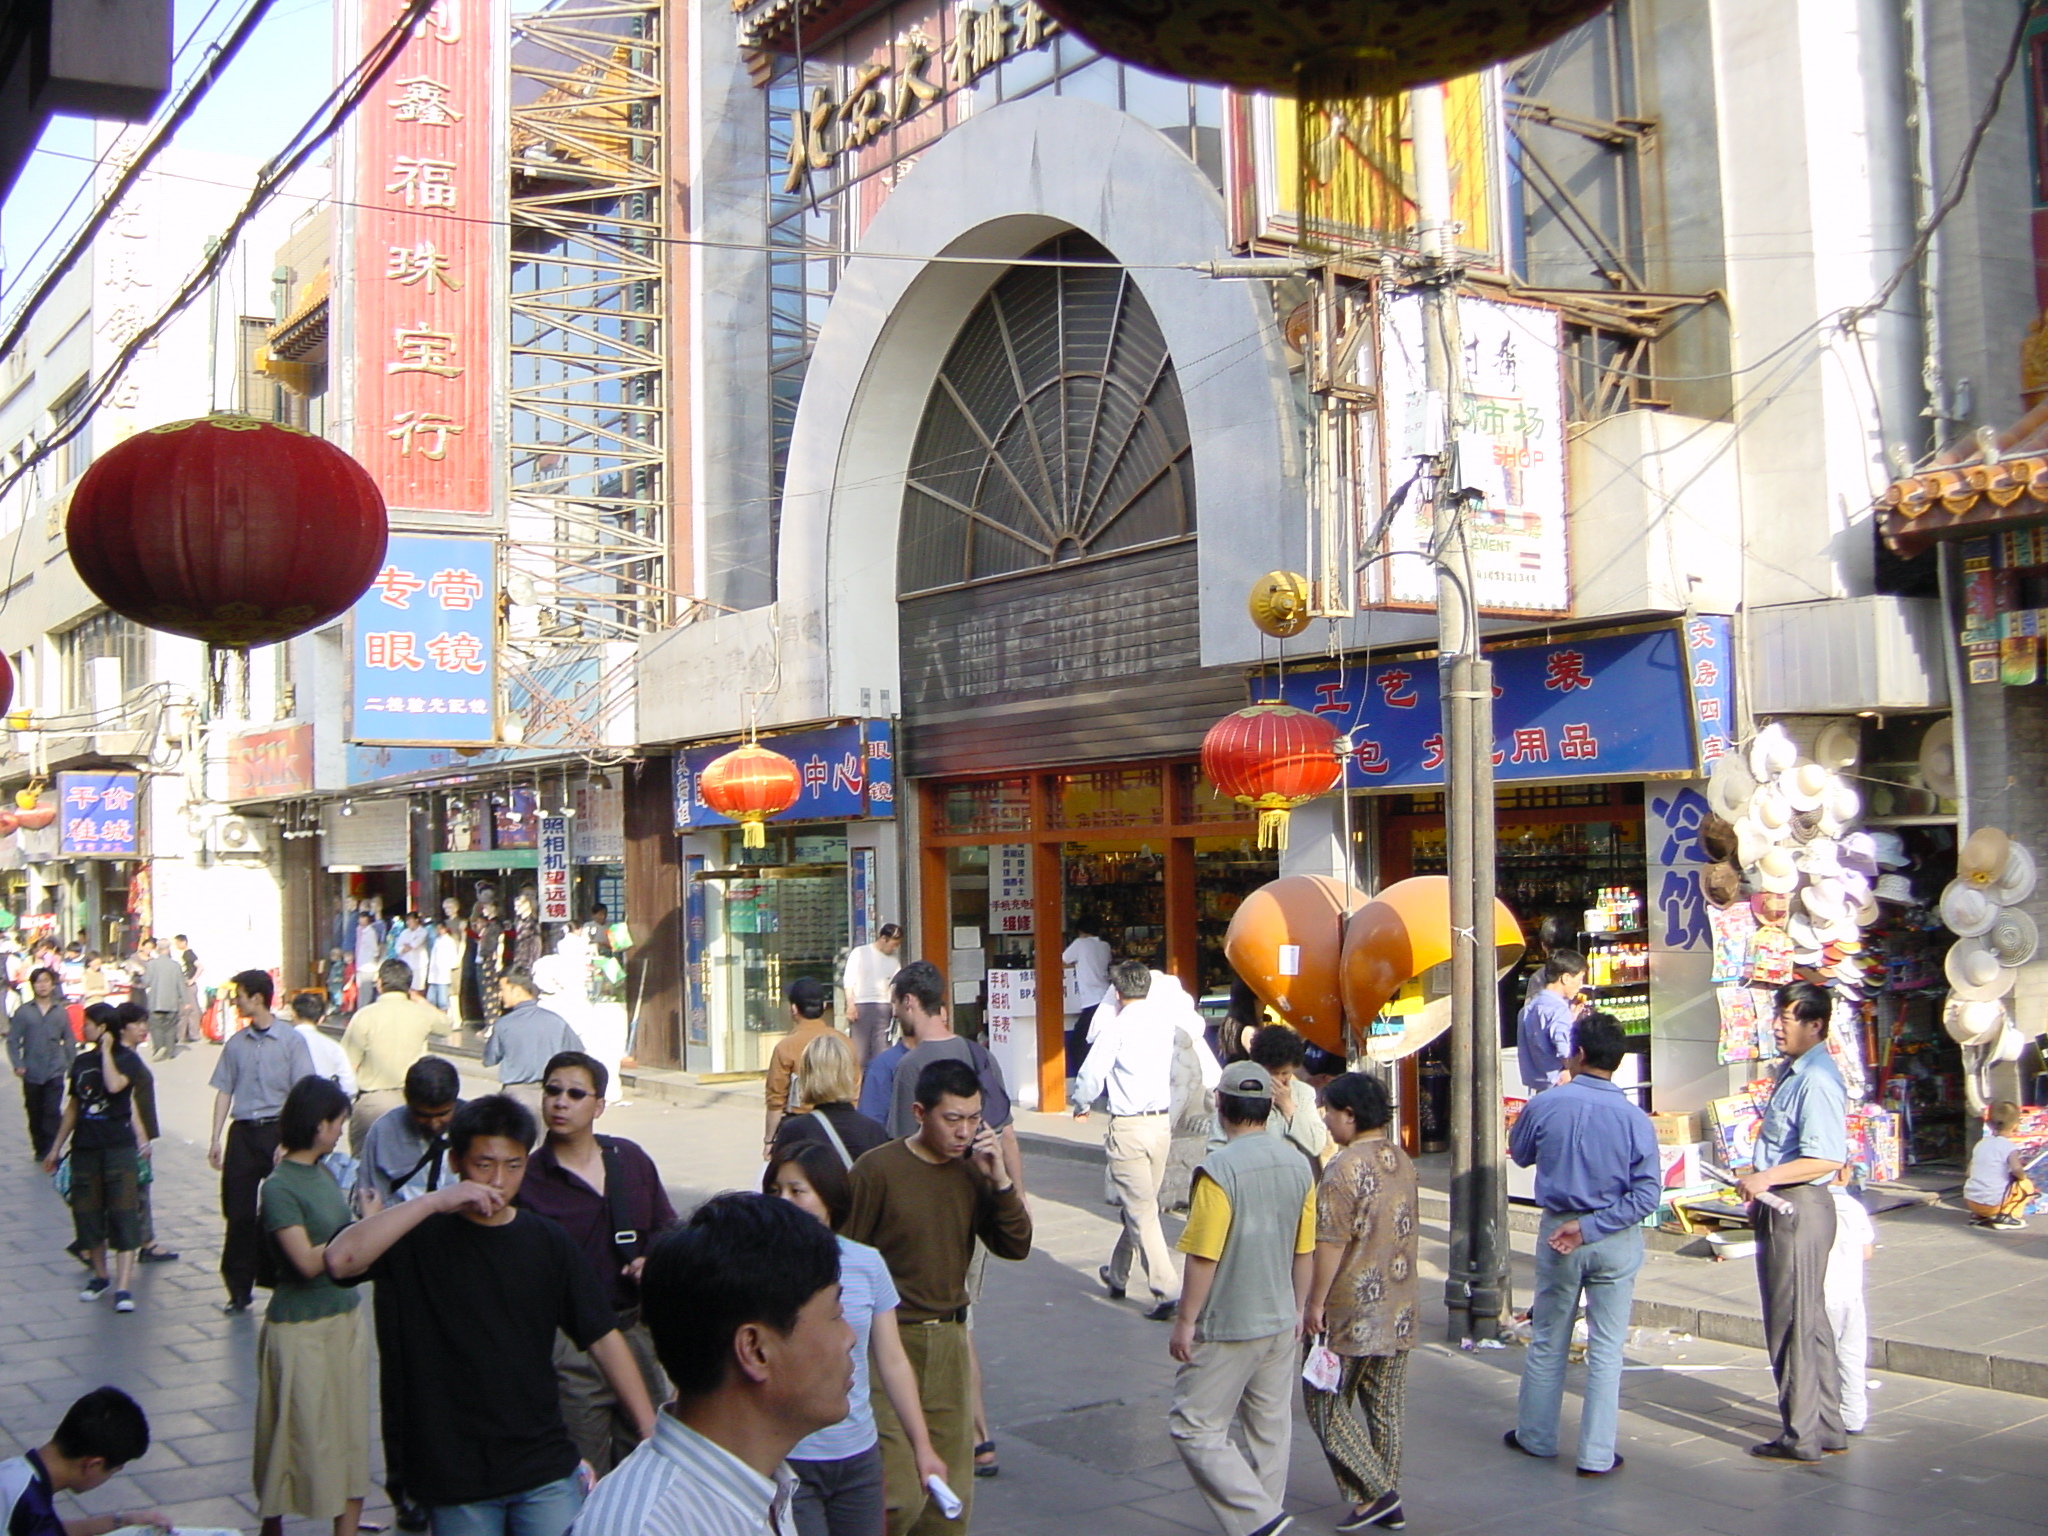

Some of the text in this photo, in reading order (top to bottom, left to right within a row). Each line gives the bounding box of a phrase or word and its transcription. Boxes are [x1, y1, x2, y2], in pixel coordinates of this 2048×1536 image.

[1492, 445, 1544, 468] SHOP
[1471, 537, 1512, 552] EMENT
[370, 566, 484, 612] 专营
[365, 632, 487, 674] 眼镜
[1313, 650, 1593, 715] 工艺装
[1690, 624, 1725, 763] 文房四宝
[867, 741, 893, 802] 眼镜
[66, 786, 135, 811] 平价
[66, 817, 135, 843] 鞋城
[542, 817, 567, 918] 照相机望远镜
[1651, 787, 1711, 950] 冷饮
[1003, 914, 1031, 931] 维修
[991, 972, 1010, 989] 手机
[991, 992, 1010, 1010] 相机
[992, 1016, 1011, 1032] 手表
